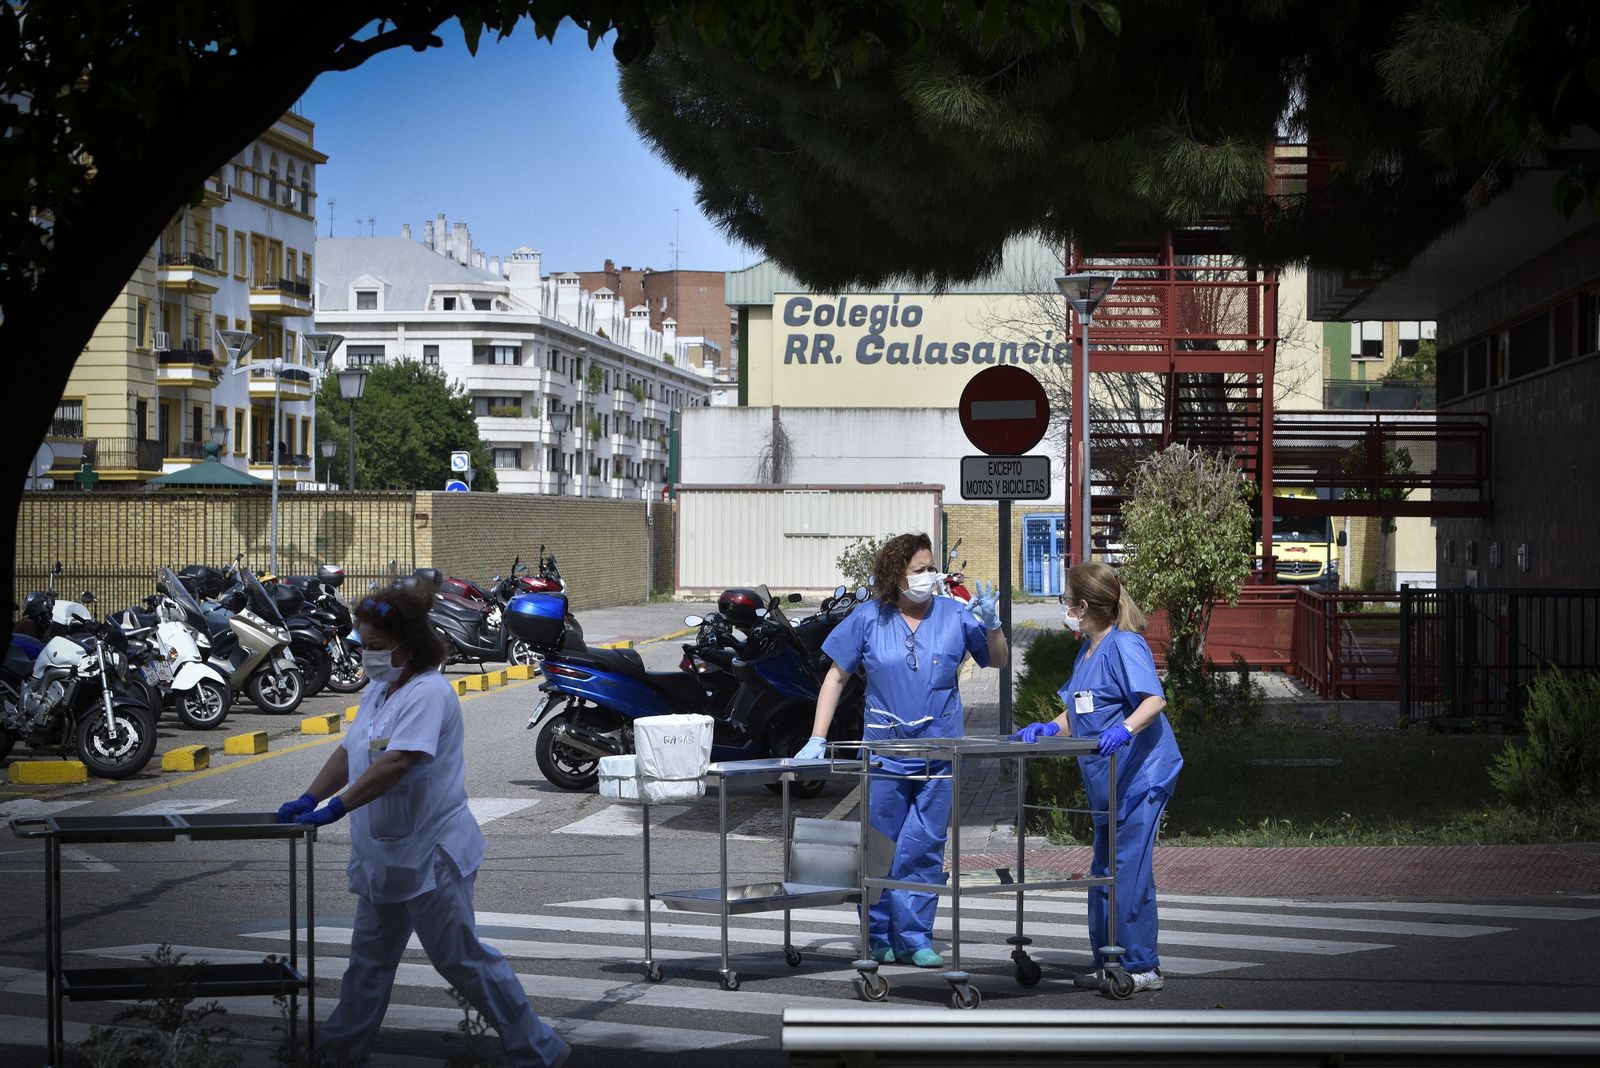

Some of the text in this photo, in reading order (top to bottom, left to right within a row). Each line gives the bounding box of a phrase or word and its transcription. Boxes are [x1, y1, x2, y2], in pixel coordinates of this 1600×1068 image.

[783, 293, 923, 335] Colegio
[783, 330, 1098, 365] RR. Calasancia
[988, 461, 1022, 476] EXCEPTO
[966, 479, 1045, 495] MOTOS Y BICICLETAS
